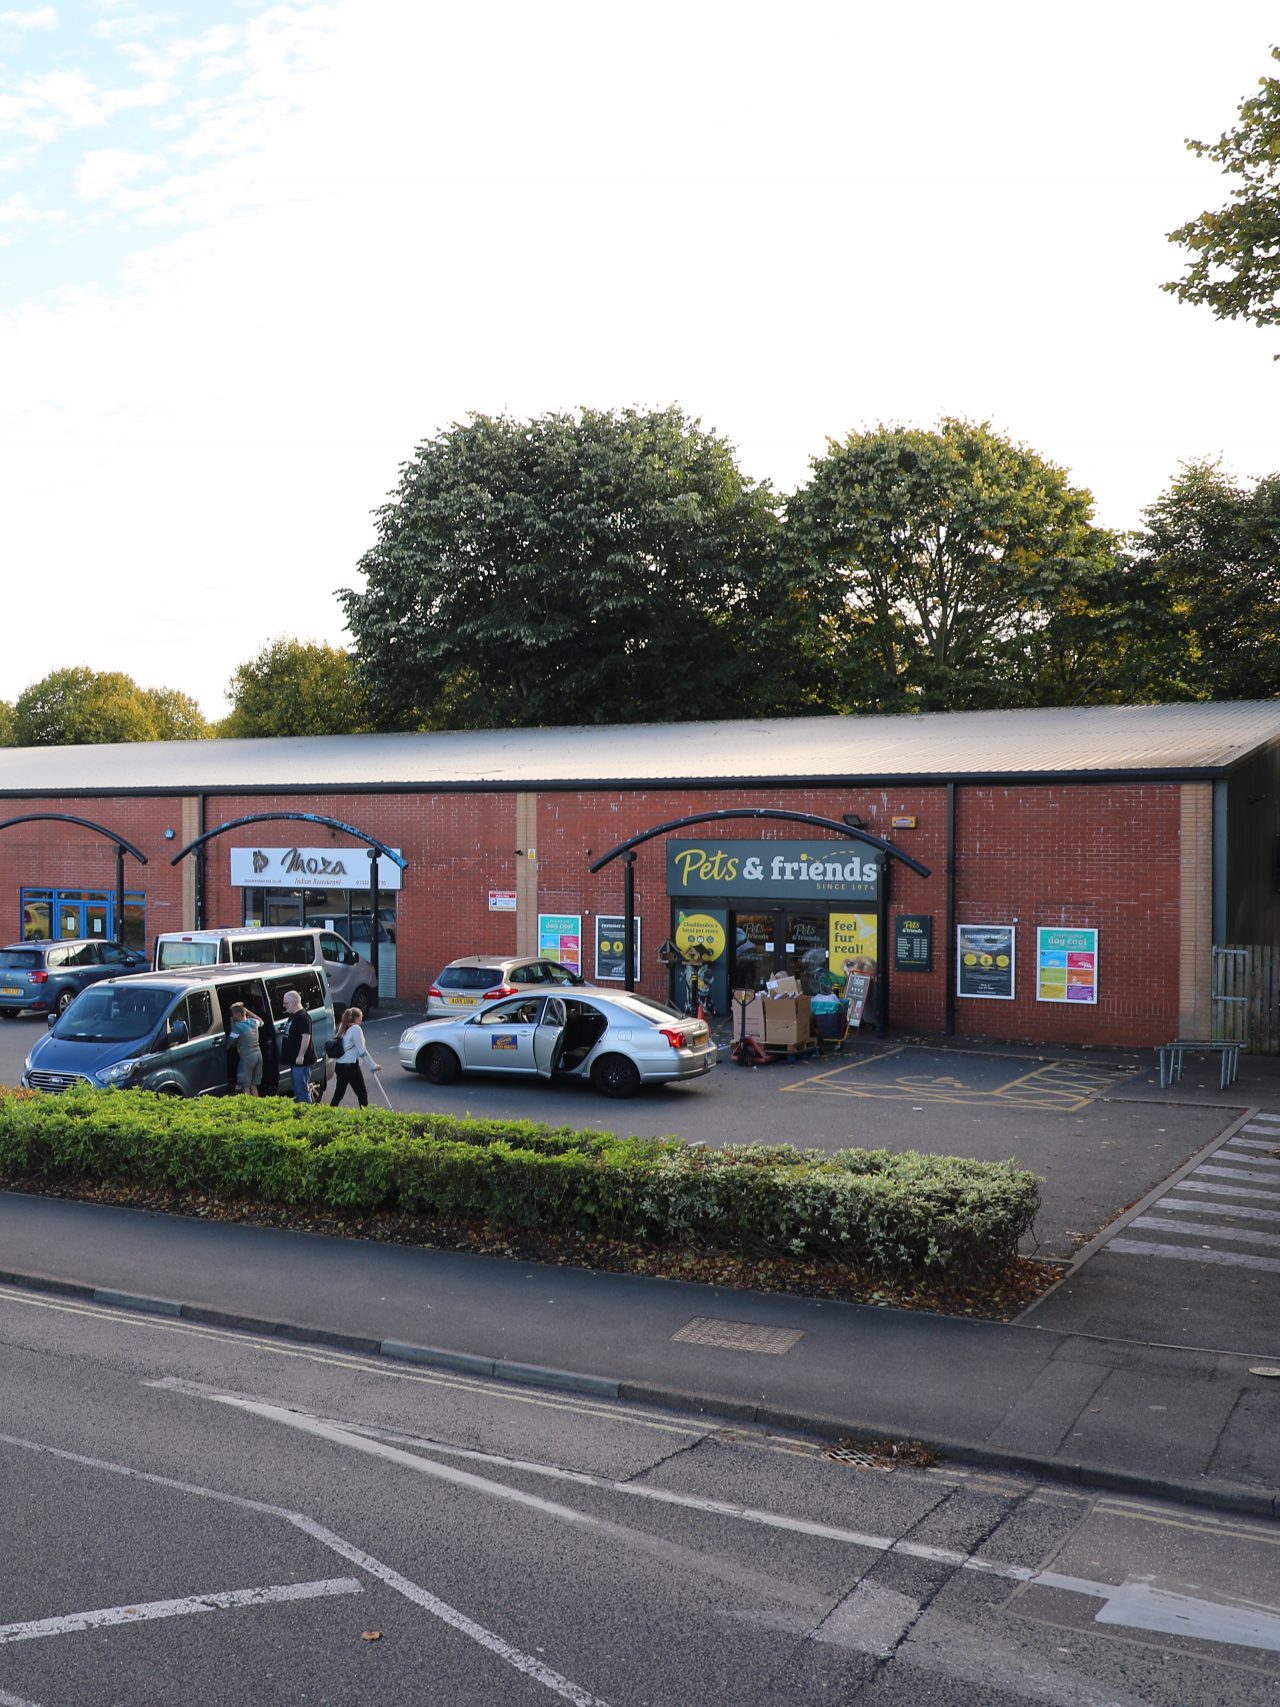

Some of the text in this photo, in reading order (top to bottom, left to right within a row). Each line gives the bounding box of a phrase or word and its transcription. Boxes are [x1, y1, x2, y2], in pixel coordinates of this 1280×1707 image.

[674, 848, 877, 887] Pets & friends
[294, 877, 311, 885] Indian
[742, 922, 765, 935] Pets
[793, 923, 816, 936] Pets
[834, 920, 857, 931] feel
[834, 932, 855, 943] fur
[1048, 936, 1087, 946] dog cool
[834, 944, 864, 954] real!
